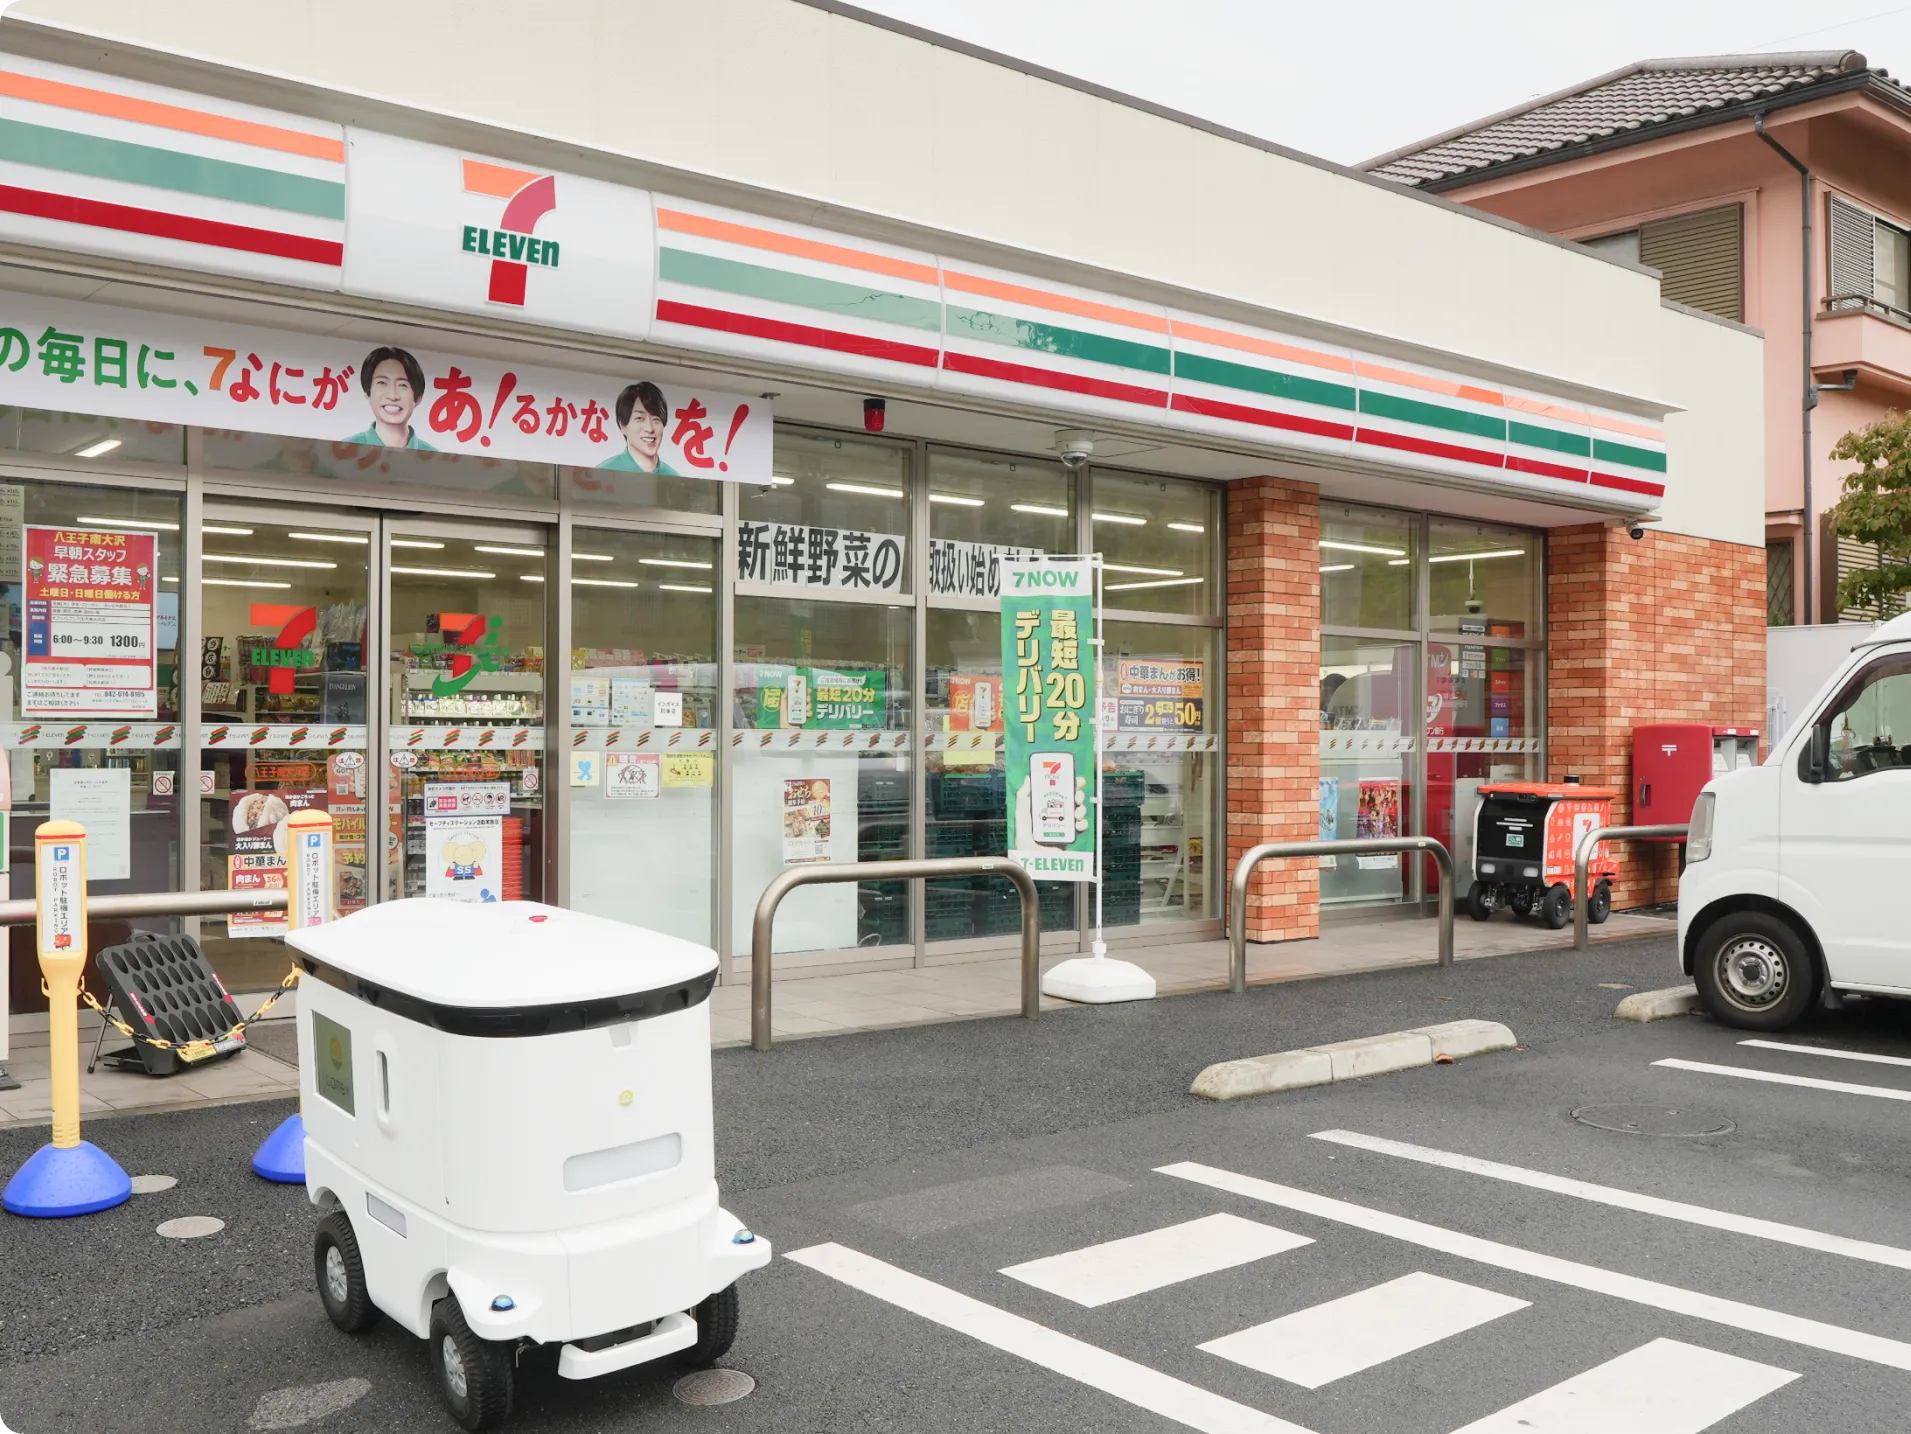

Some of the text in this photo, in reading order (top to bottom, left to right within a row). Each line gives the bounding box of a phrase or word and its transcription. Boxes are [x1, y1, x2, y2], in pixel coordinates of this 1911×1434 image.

[462, 158, 557, 306] 7
[53, 531, 126, 546] 八王子南大沢
[53, 545, 127, 562] 早朝スタッフ
[738, 521, 900, 589] 新鮮野菜の
[47, 562, 132, 586] 緊急募集
[1012, 570, 1079, 588] 7NOW
[250, 603, 317, 695] 7
[1015, 608, 1042, 743] デリバリー
[1046, 609, 1086, 742] 最短20分
[1129, 664, 1200, 682] 中華まんがお得!
[816, 686, 875, 703] 最短20分
[816, 703, 874, 719] デリバリー
[1120, 705, 1145, 714] おにぎり
[1125, 715, 1139, 725] 寿司
[289, 799, 310, 807] 肉まん
[244, 856, 287, 867] 中華まん
[456, 866, 472, 874] SS
[235, 874, 260, 884] 肉まん
